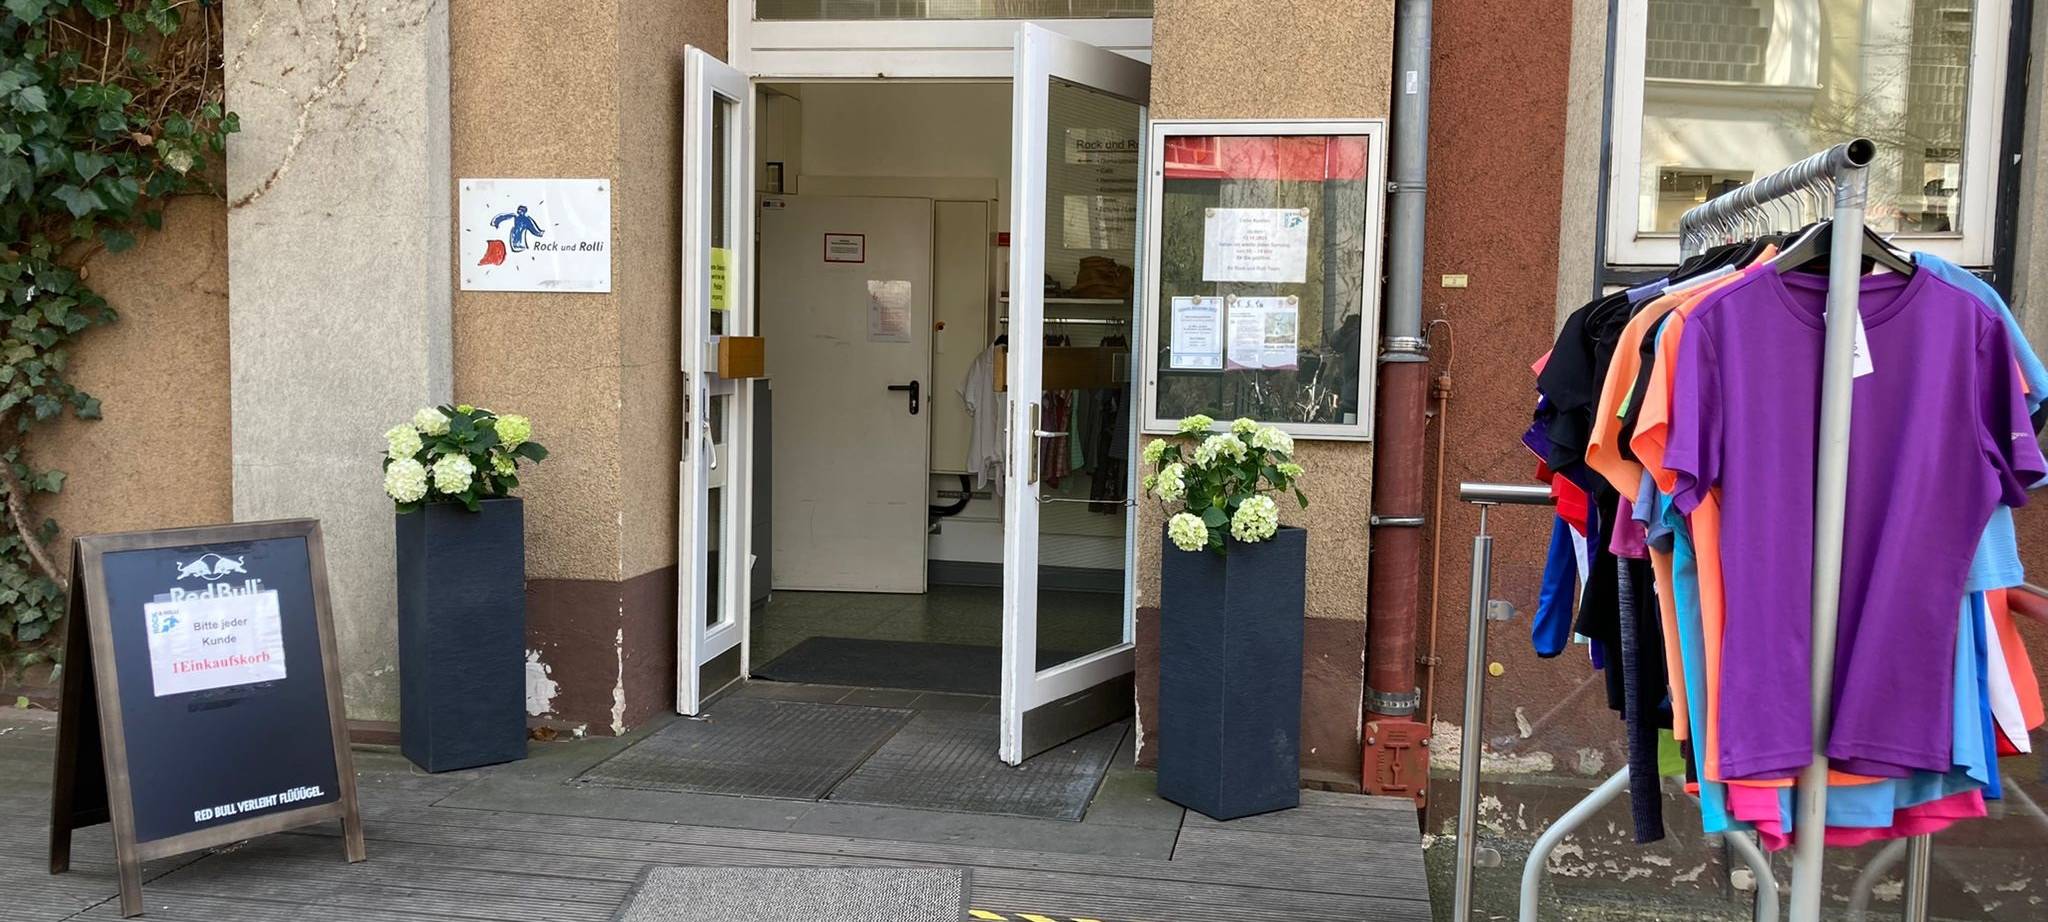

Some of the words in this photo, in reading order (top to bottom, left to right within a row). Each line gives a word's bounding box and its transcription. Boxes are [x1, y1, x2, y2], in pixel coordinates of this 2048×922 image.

[1076, 139, 1102, 149] Rock
[1105, 139, 1125, 149] und
[533, 241, 558, 251] Rock
[561, 243, 576, 251] und
[579, 241, 604, 251] Rolli
[193, 621, 218, 631] Bitte
[221, 618, 248, 630] jeder
[202, 635, 237, 646] Kunde
[194, 808, 213, 822] RED
[214, 803, 237, 818] BULL
[237, 794, 278, 813] VERLEIHT
